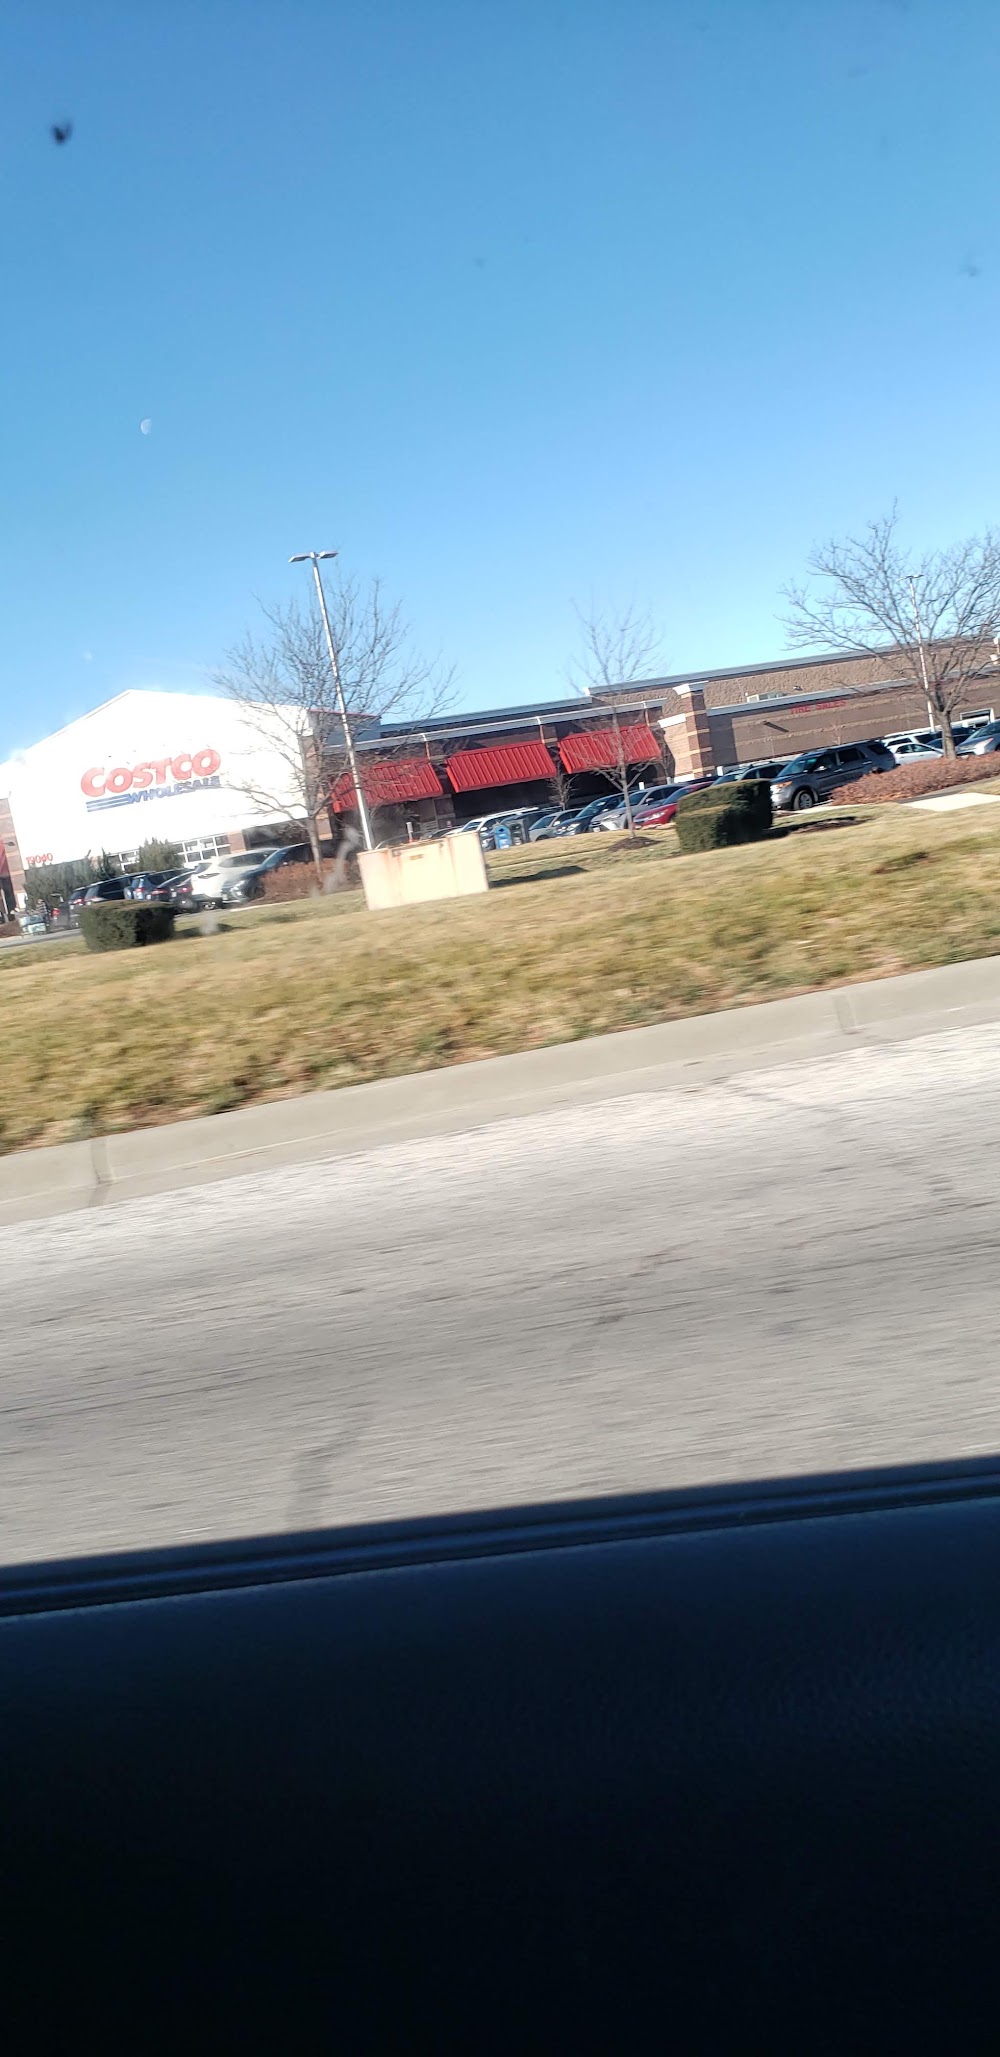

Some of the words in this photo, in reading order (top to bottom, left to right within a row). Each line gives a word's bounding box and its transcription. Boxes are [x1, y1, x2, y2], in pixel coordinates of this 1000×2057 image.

[815, 699, 847, 710] SALES
[80, 748, 221, 797] COSTCO
[127, 775, 220, 804] WHOLESALE
